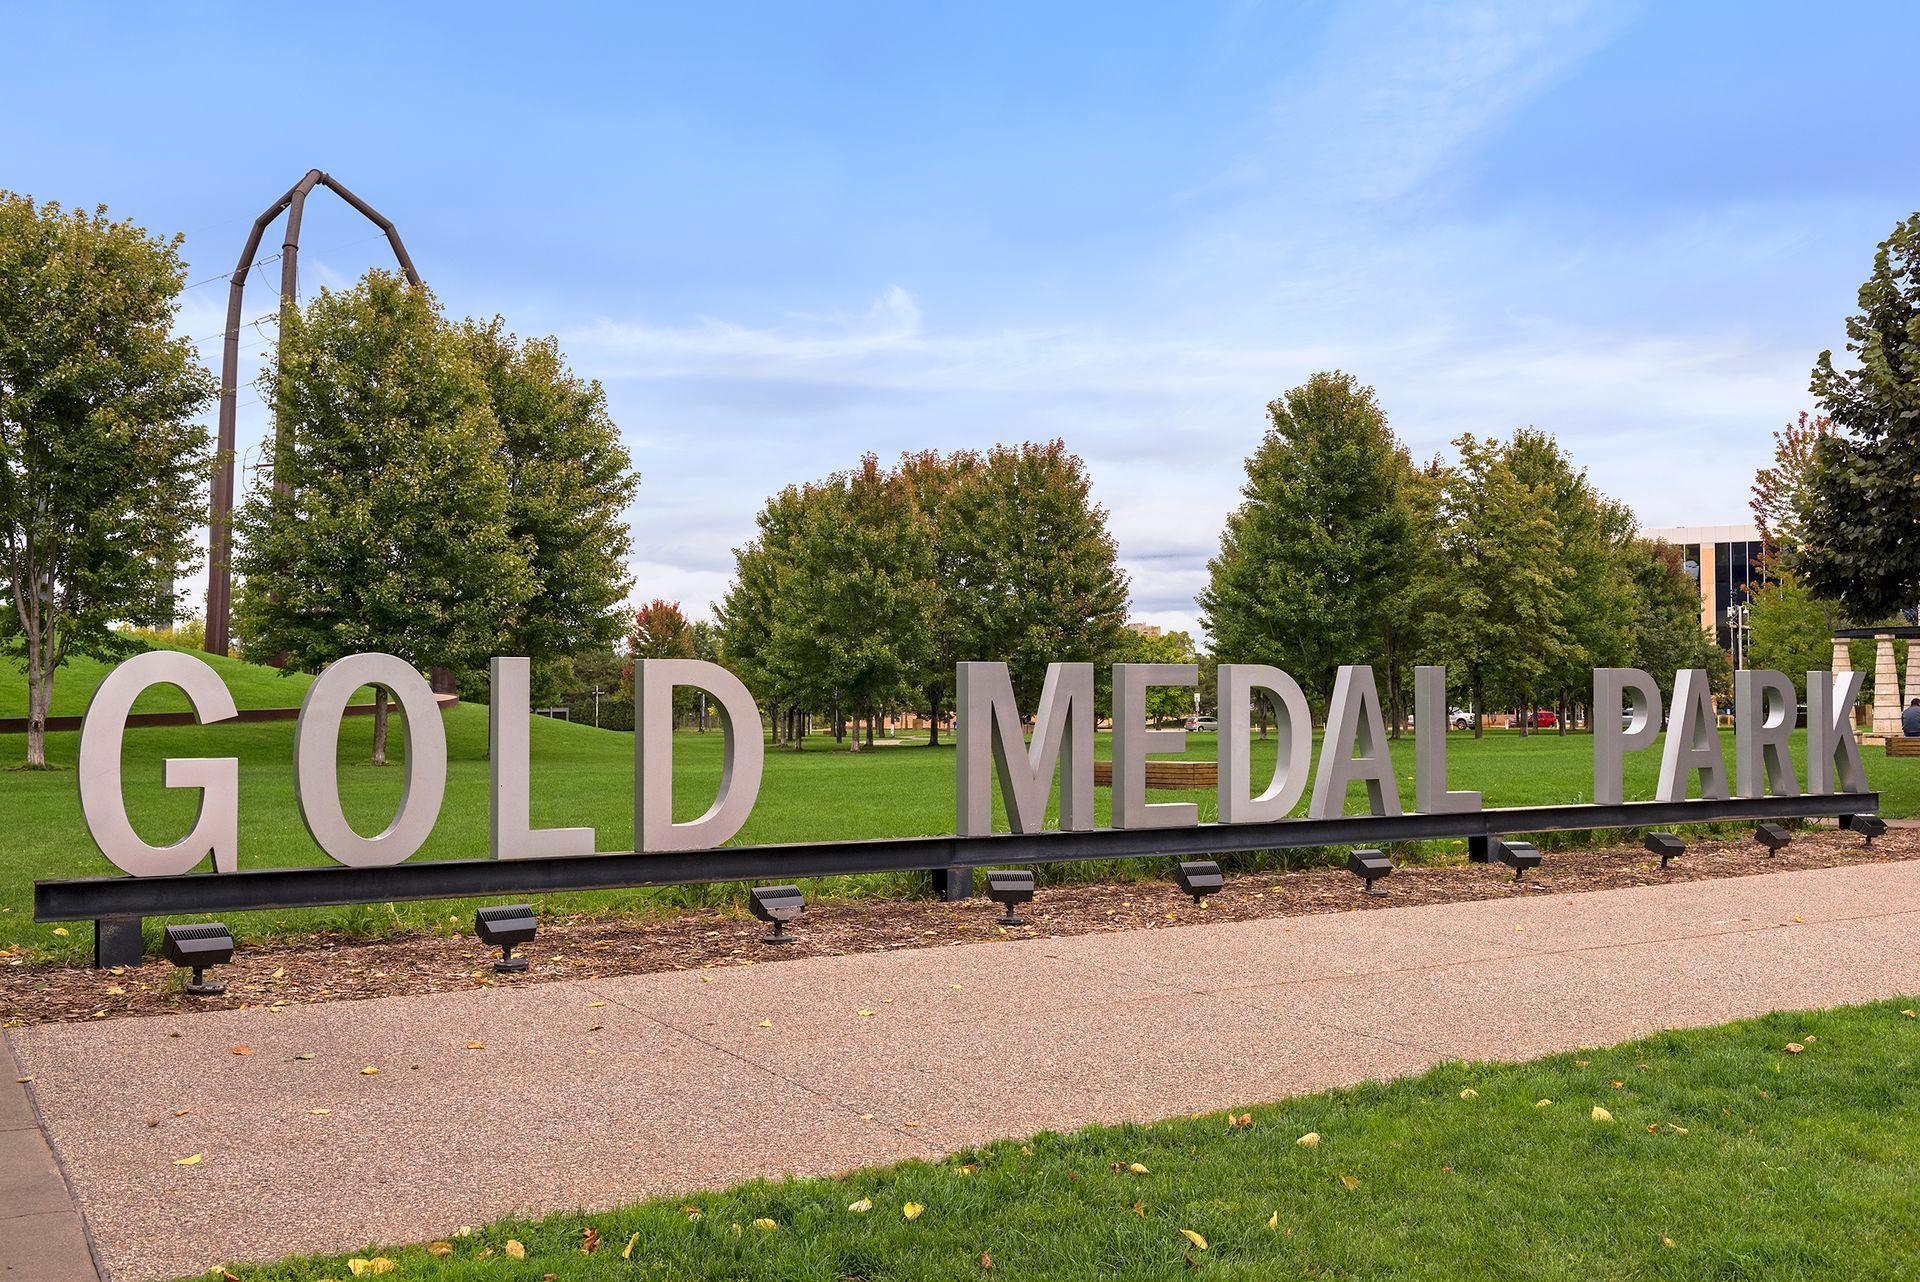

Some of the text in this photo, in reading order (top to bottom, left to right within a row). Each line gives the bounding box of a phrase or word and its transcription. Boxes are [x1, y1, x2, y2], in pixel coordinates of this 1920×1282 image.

[77, 650, 1869, 877] GOLD MEDAL PARK
